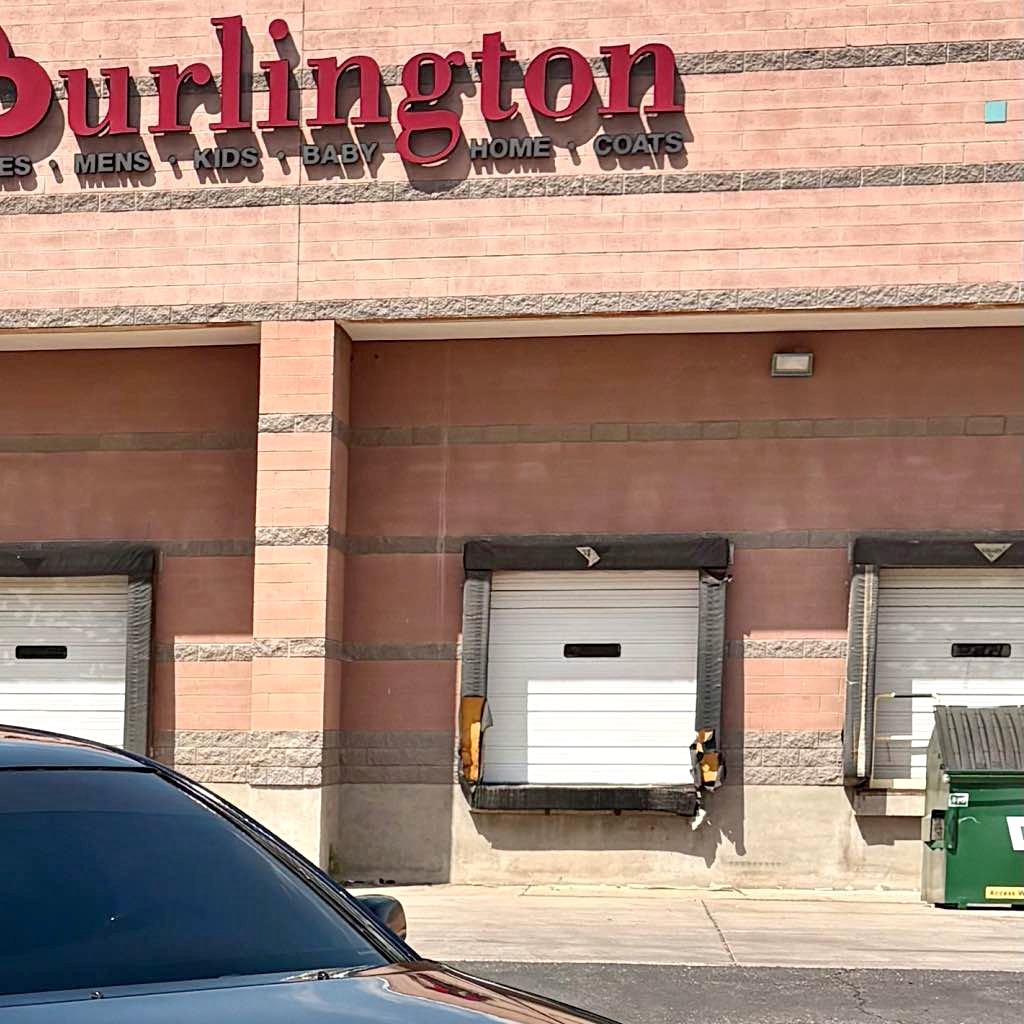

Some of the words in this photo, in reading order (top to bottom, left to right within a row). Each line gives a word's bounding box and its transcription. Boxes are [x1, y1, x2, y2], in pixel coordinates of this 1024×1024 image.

[74, 151, 152, 174] MENS
[193, 147, 260, 169] KIDS
[303, 142, 378, 165] BABY
[470, 137, 553, 160] HOME
[593, 132, 684, 156] COATS
